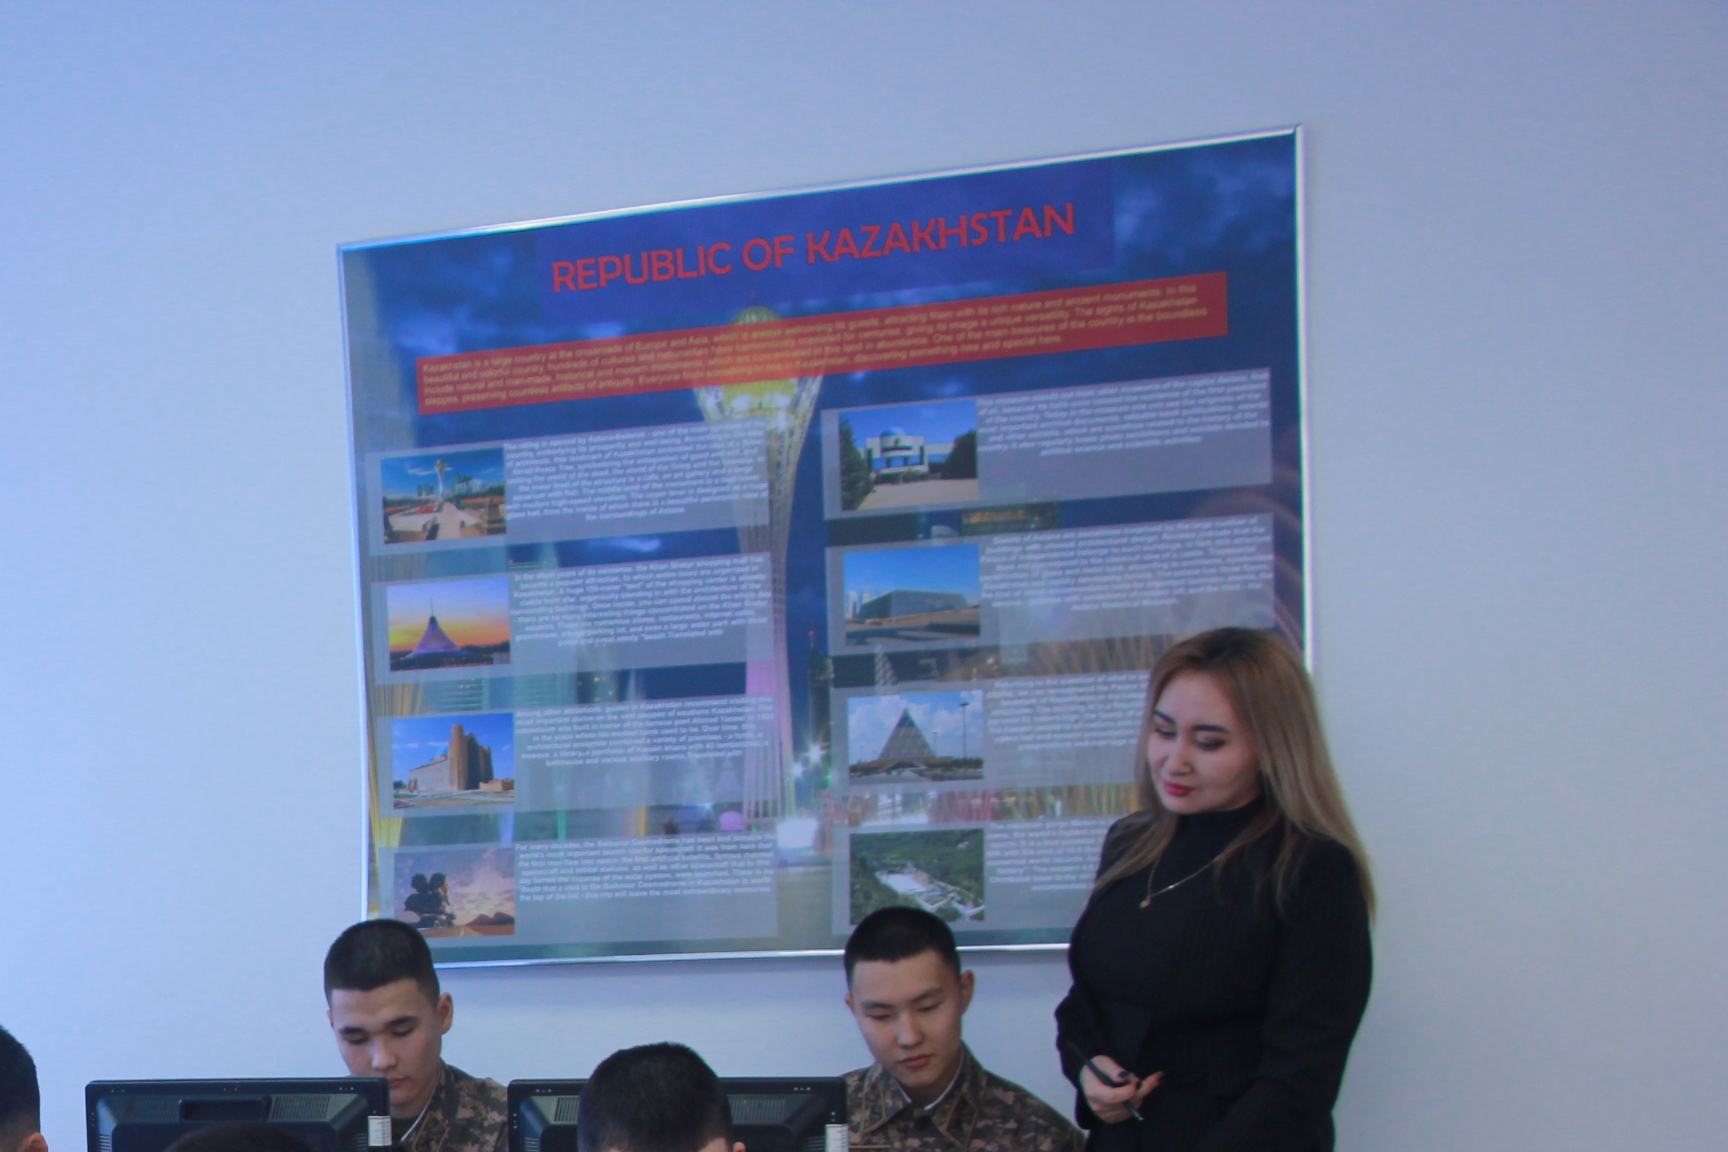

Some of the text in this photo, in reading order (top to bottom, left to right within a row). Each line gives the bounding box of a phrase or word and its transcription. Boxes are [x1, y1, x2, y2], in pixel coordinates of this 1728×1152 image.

[553, 204, 1076, 293] REPUBLIC OF KAZAKHSTAN
